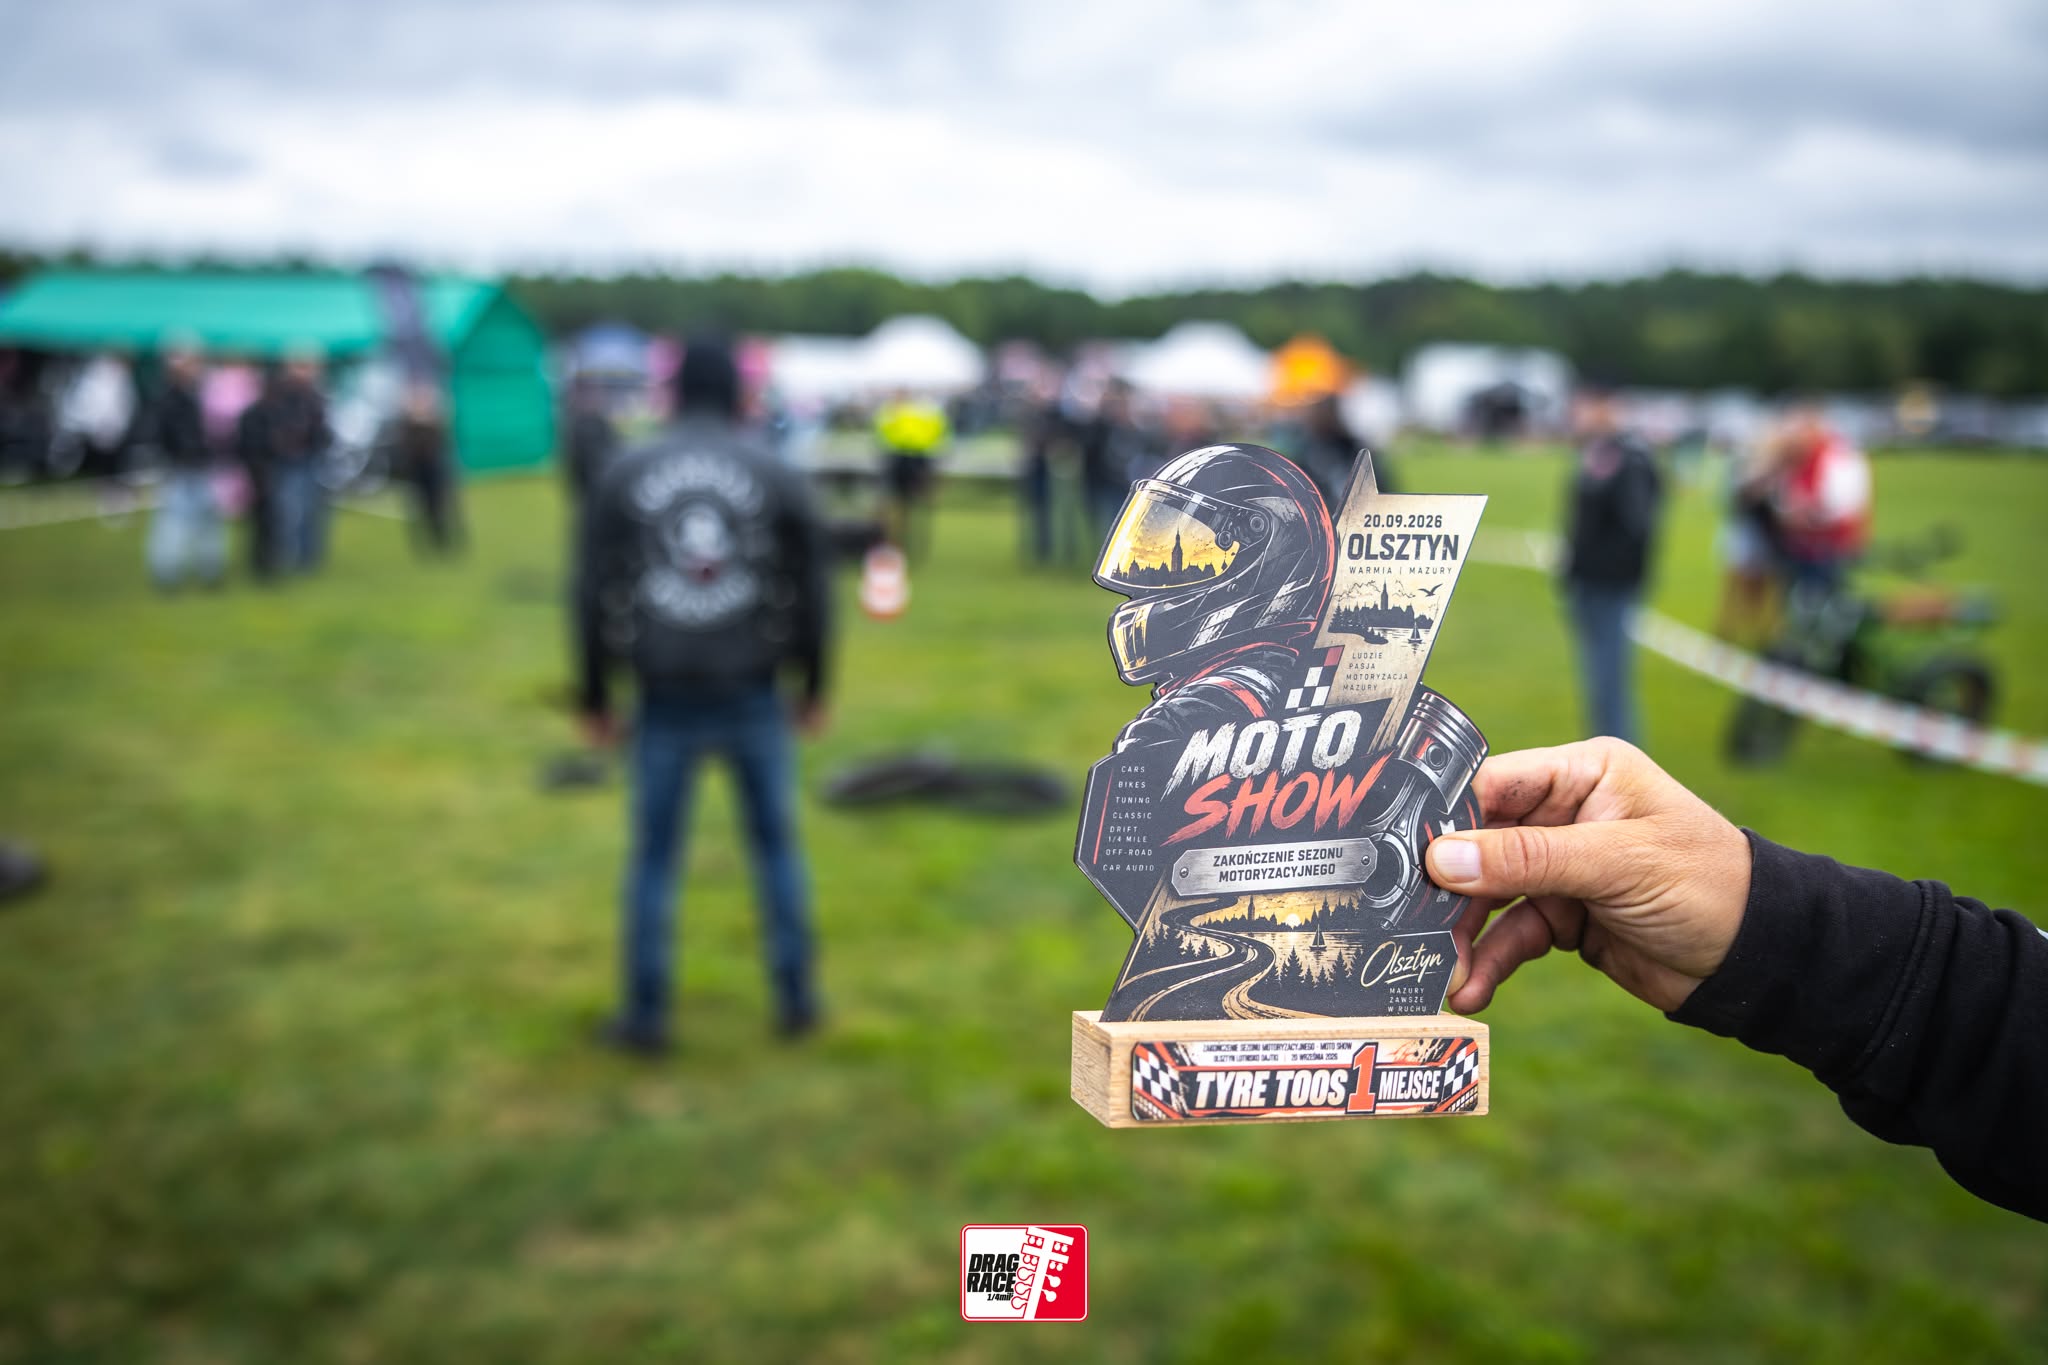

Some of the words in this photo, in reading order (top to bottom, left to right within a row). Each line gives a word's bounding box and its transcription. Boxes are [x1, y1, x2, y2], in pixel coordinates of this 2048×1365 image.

[1363, 514, 1443, 529] 20.09.2026
[1347, 533, 1459, 561] OLSZTYN
[1349, 566, 1393, 575] WARMIA
[1409, 566, 1453, 575] MAZURY
[1352, 652, 1383, 660] LUDZIE
[1348, 662, 1376, 670] PASJA
[1346, 673, 1409, 681] MOTORYZACJA
[1160, 709, 1363, 802] MOTO
[1121, 765, 1145, 773] CARS
[1118, 781, 1147, 789] BIKES
[1115, 796, 1151, 804] TUNING
[1160, 750, 1395, 847] SHOW
[1109, 825, 1138, 833] DRIFT
[1125, 835, 1148, 843] MILE
[1105, 848, 1153, 856] OFF-ROAD
[1213, 851, 1295, 868] ZAKOŃCZENIE
[1297, 847, 1343, 862] SEZONU
[1102, 864, 1121, 872] CAR
[1125, 863, 1155, 871] AUDIO
[1218, 863, 1336, 883] MOTORYZACYJNEGO
[1360, 940, 1445, 987] Olsztyn
[1337, 1041, 1353, 1050] SHOW
[1195, 1070, 1271, 1109] TYRE
[1275, 1068, 1349, 1107] TOOS
[1345, 1042, 1379, 1114] 1
[1378, 1070, 1442, 1101] MIEJSCE
